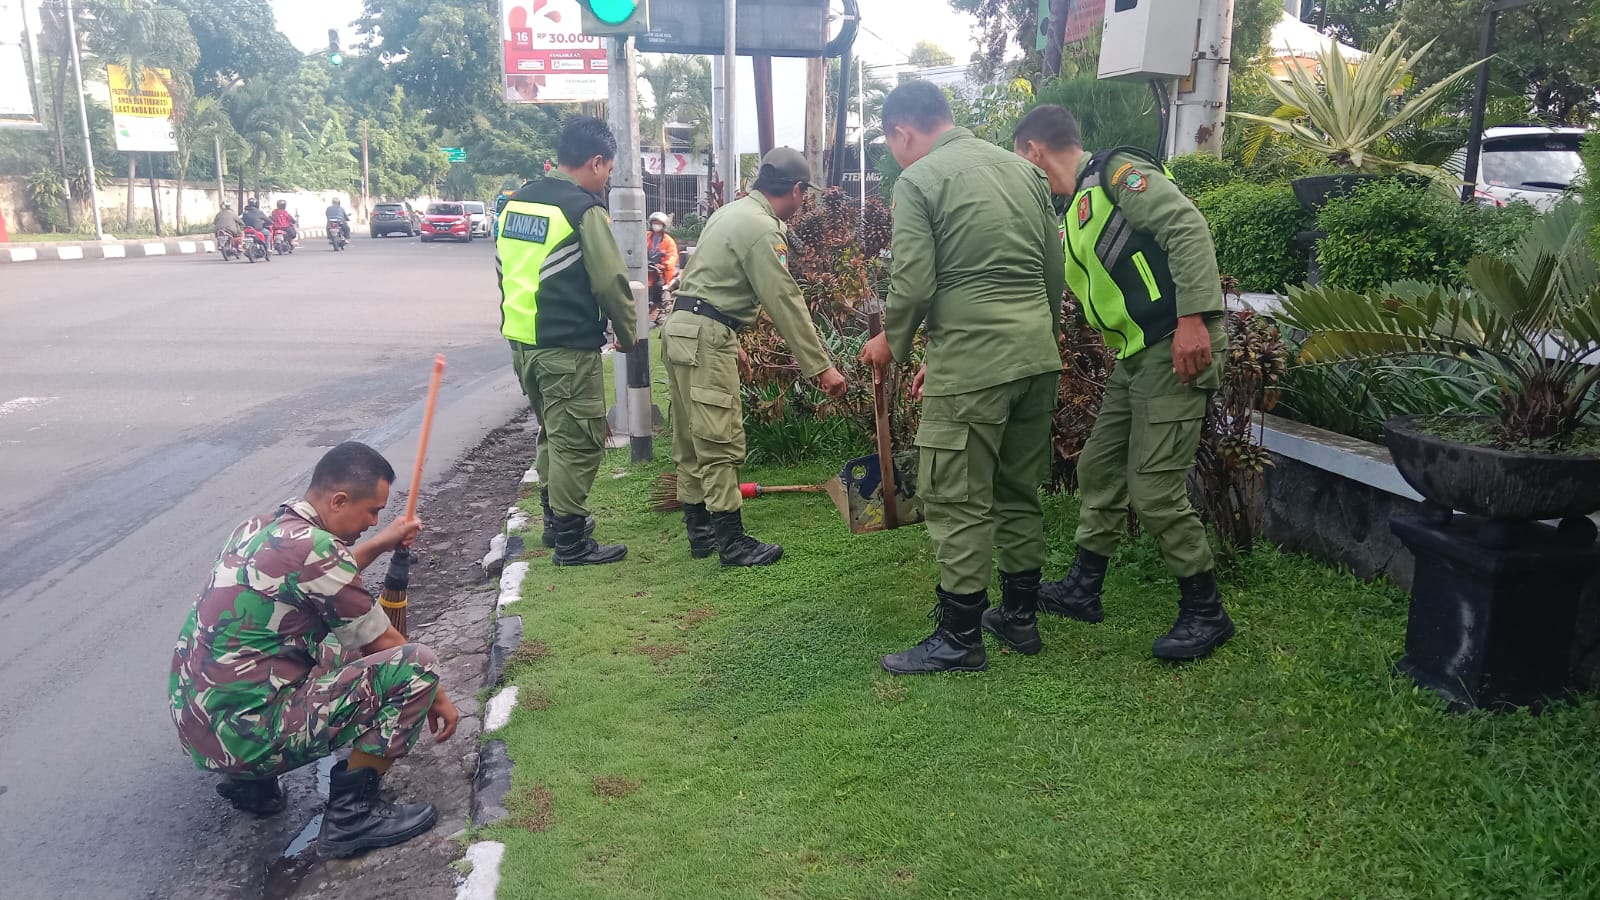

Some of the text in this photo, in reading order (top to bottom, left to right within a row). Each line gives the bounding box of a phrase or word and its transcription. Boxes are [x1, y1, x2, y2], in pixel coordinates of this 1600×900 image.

[516, 32, 528, 41] 16
[549, 33, 594, 43] 30.000
[505, 214, 547, 237] LINMAS
